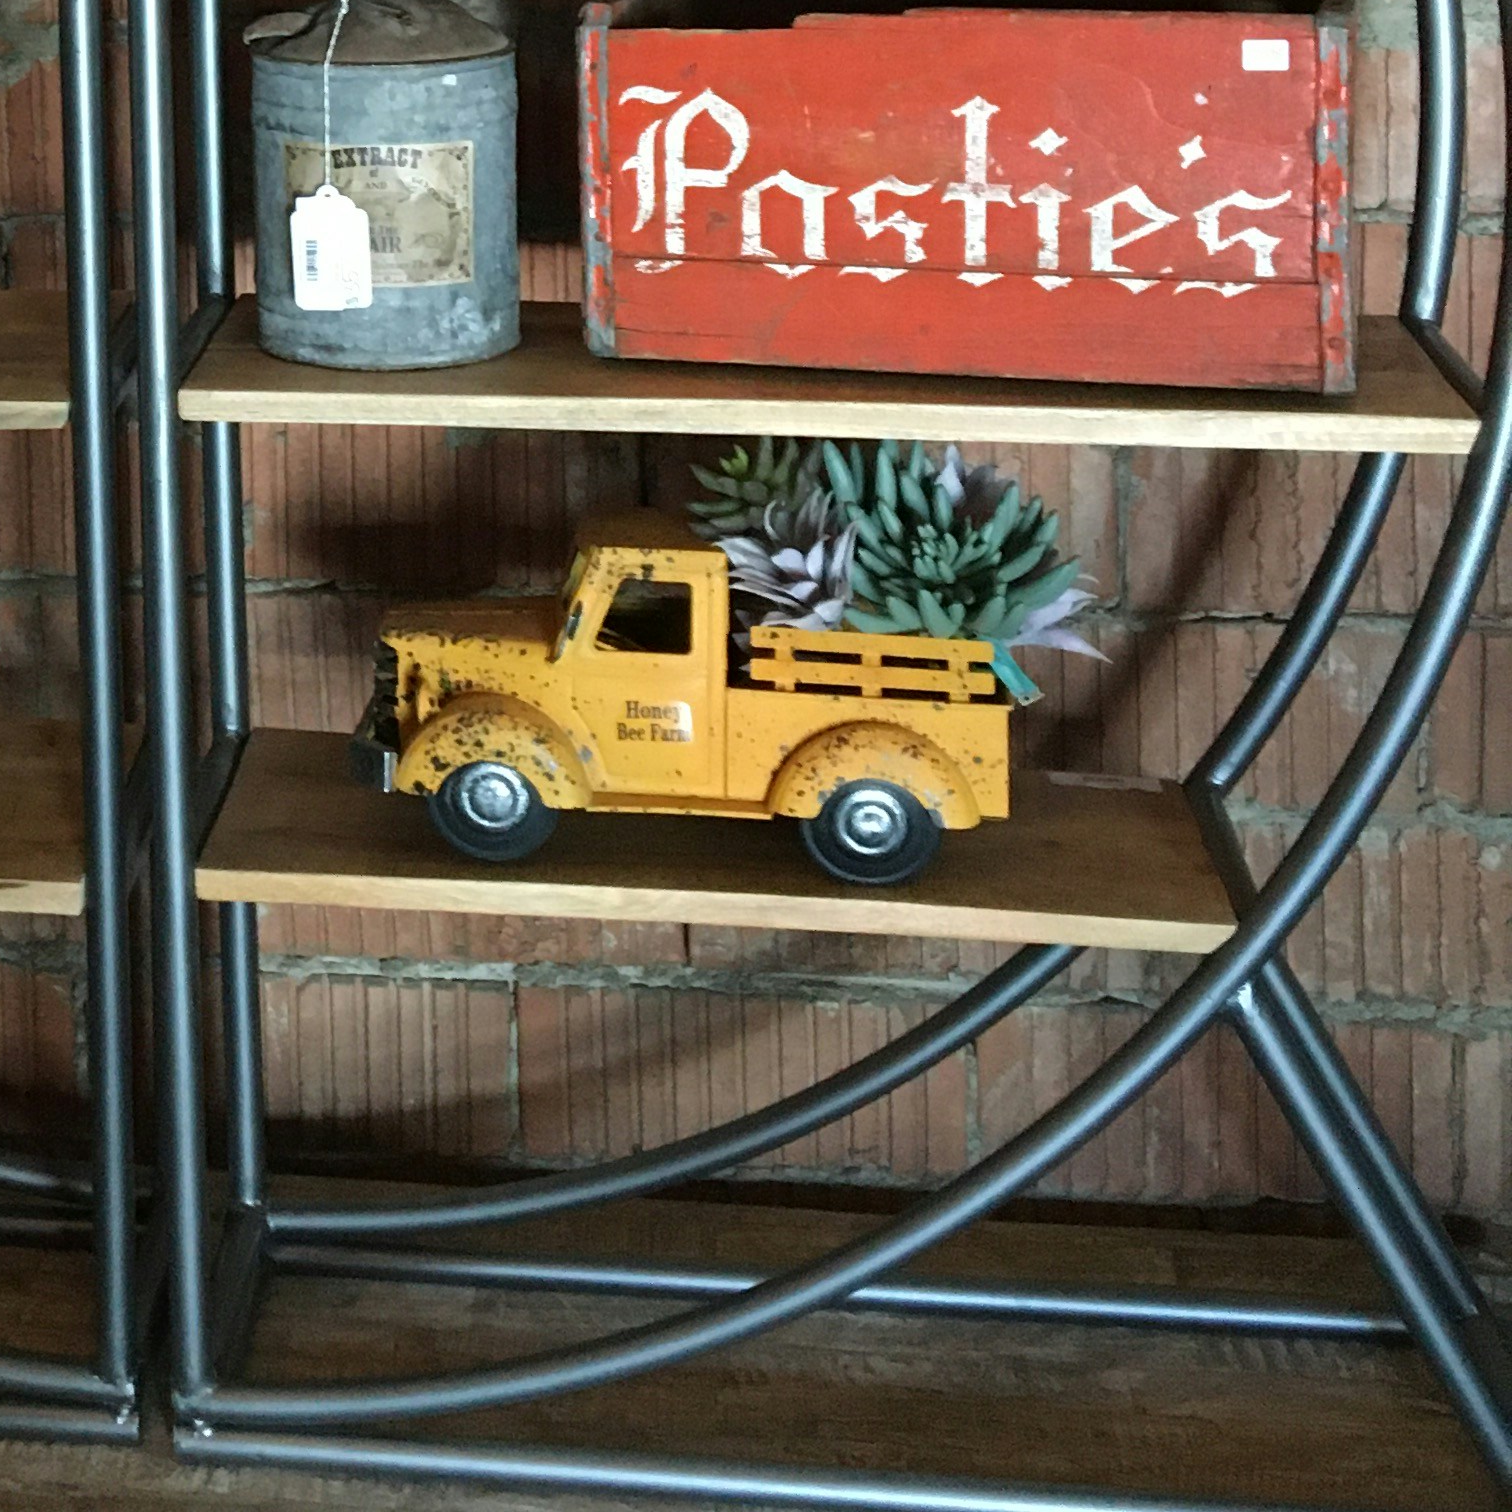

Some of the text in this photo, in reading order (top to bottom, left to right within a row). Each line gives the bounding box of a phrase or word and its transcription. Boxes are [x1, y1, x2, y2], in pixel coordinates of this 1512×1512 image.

[331, 147, 423, 169] EXTRACT
[617, 84, 1293, 297] Pasties
[625, 700, 681, 724] Honey
[616, 722, 646, 741] Bee
